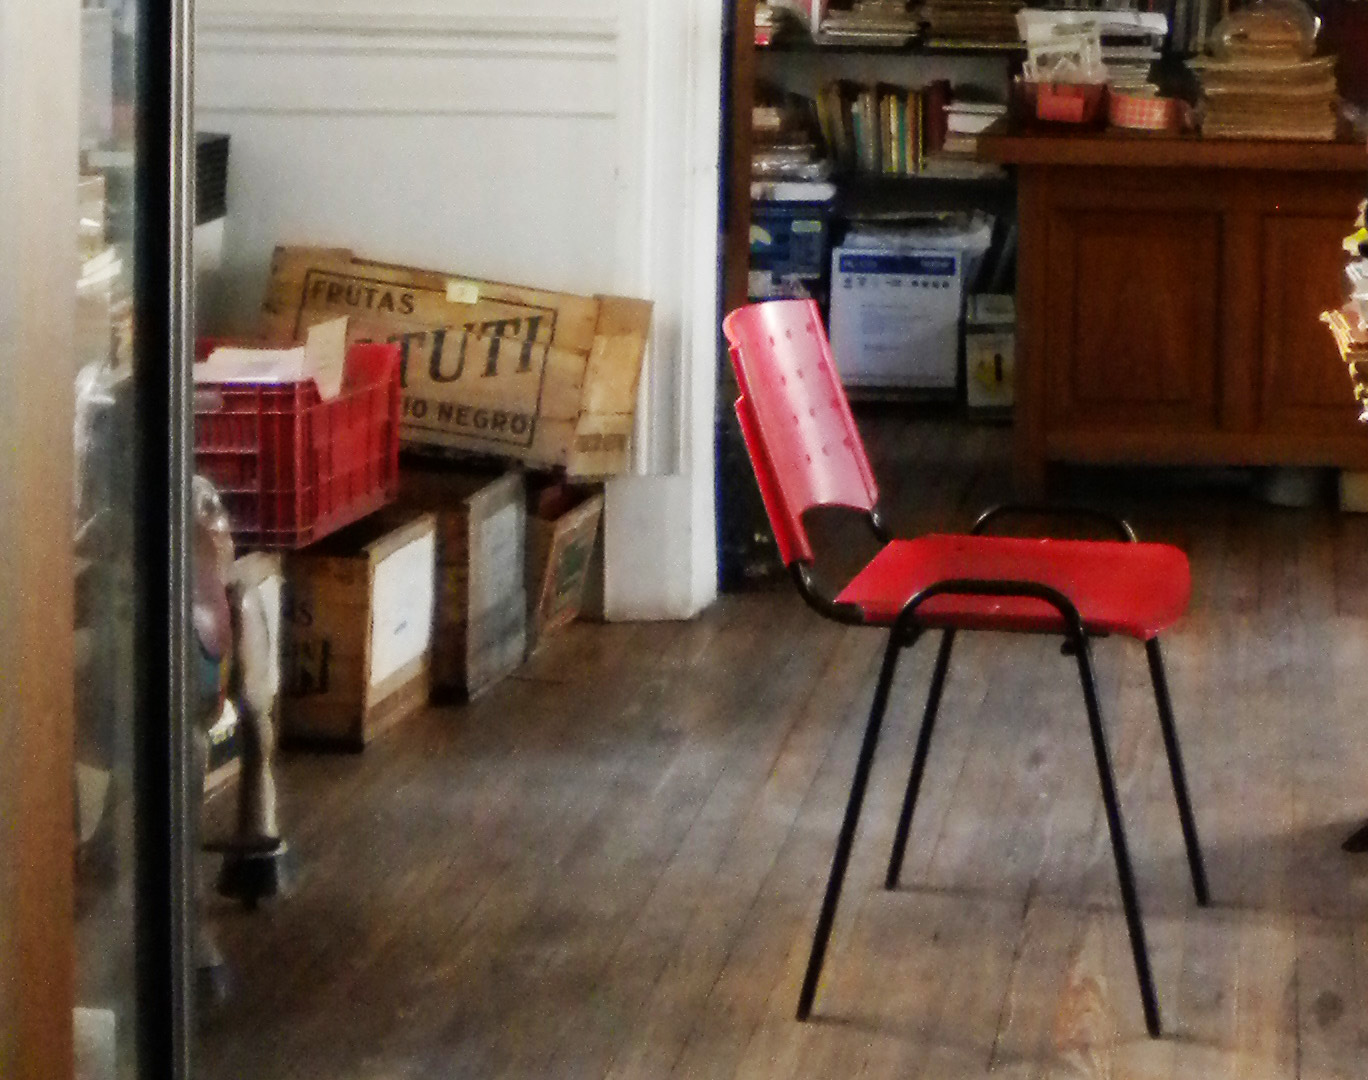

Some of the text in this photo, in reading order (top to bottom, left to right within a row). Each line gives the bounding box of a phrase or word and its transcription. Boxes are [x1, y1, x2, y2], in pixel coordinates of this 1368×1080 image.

[310, 280, 415, 315] FRUTAS
[386, 314, 543, 389] TUTI
[402, 396, 528, 435] IO NEGRO
